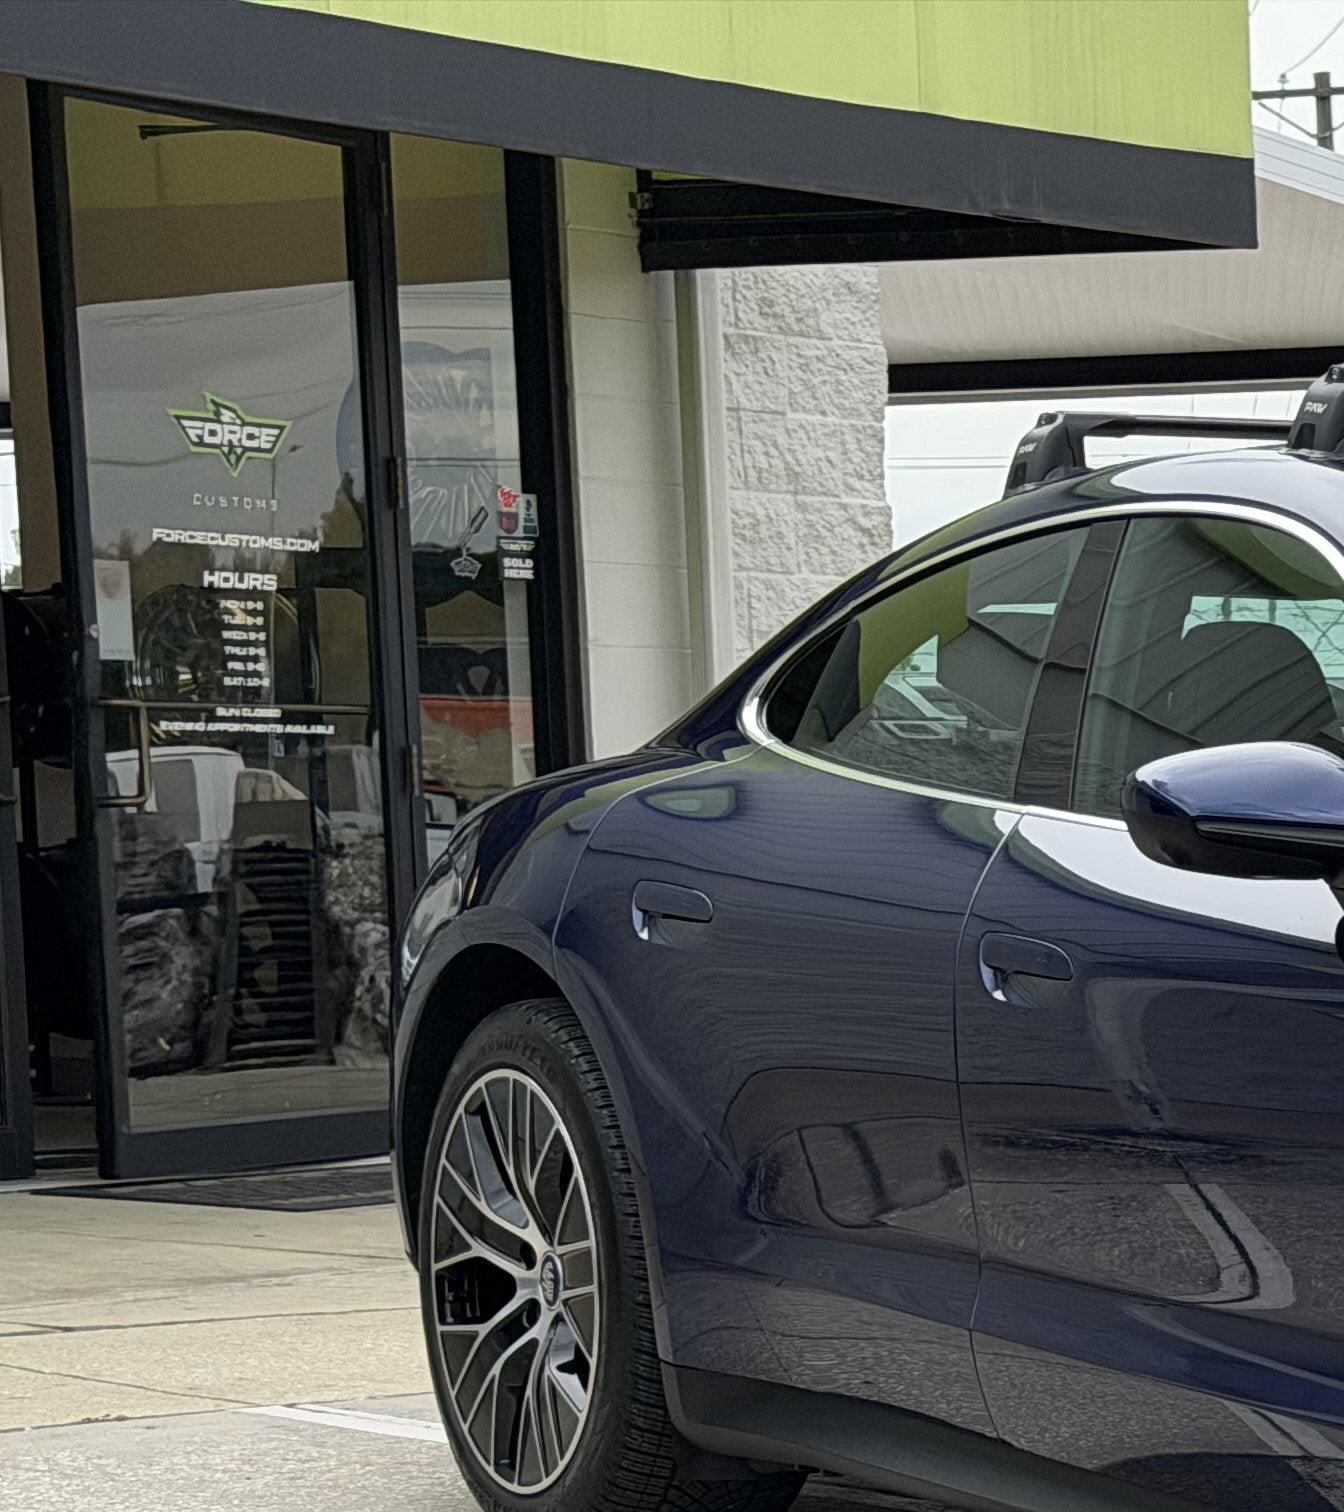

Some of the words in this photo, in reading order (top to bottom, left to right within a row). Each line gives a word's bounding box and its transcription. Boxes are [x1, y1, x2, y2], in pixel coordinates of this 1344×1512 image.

[179, 418, 281, 449] FORCE
[192, 492, 278, 511] CUSTOMS
[151, 527, 321, 552] FORCECUSTOMS.COM
[502, 556, 534, 568] SOLD
[202, 570, 278, 591] HOURS
